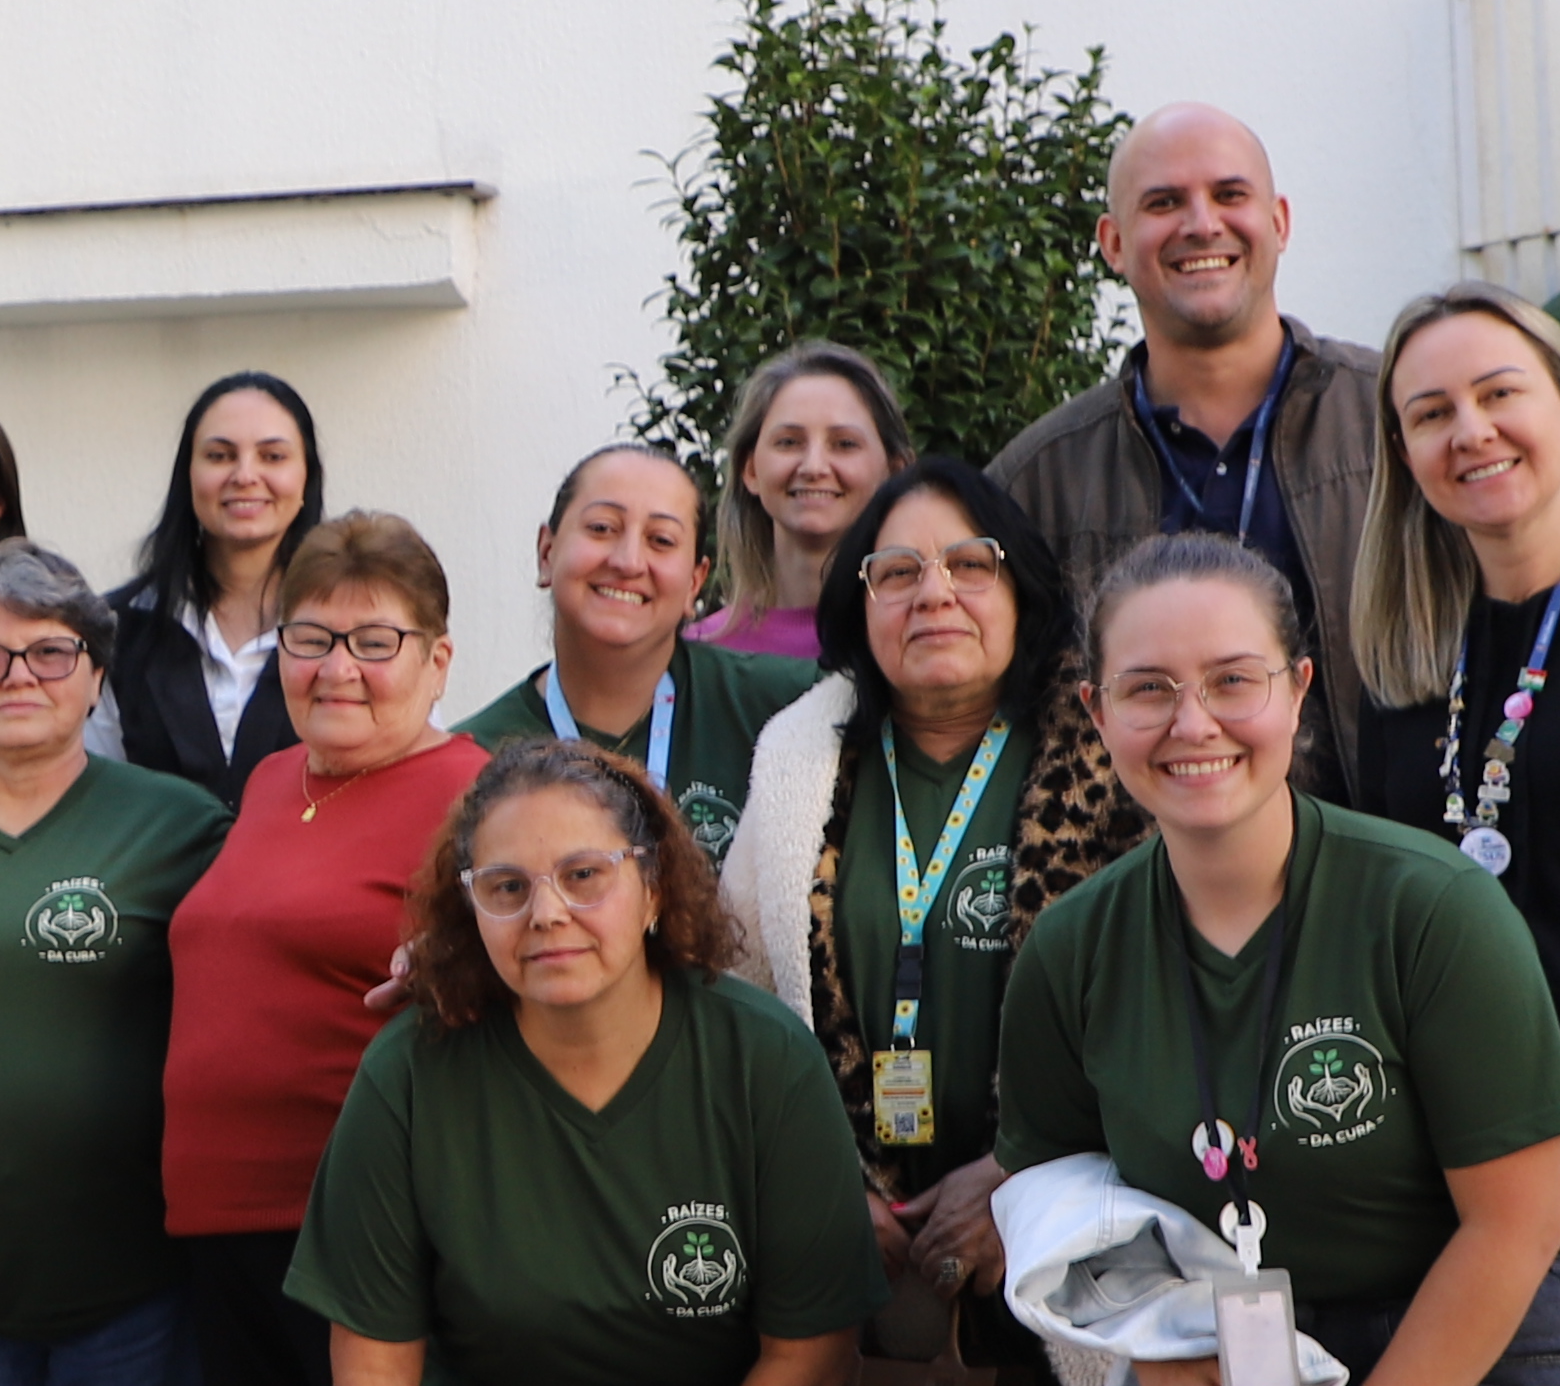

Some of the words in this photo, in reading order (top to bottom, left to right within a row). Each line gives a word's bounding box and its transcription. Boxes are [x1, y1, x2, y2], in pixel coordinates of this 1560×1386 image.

[46, 949, 64, 962] DA
[65, 950, 97, 963] CURA
[1290, 1017, 1354, 1042] RAÍZES
[1310, 1133, 1333, 1148] DA
[1335, 1120, 1377, 1144] CURA
[667, 1199, 725, 1223] RAÍZES
[676, 1306, 695, 1318] DA
[697, 1302, 731, 1318] CURA
